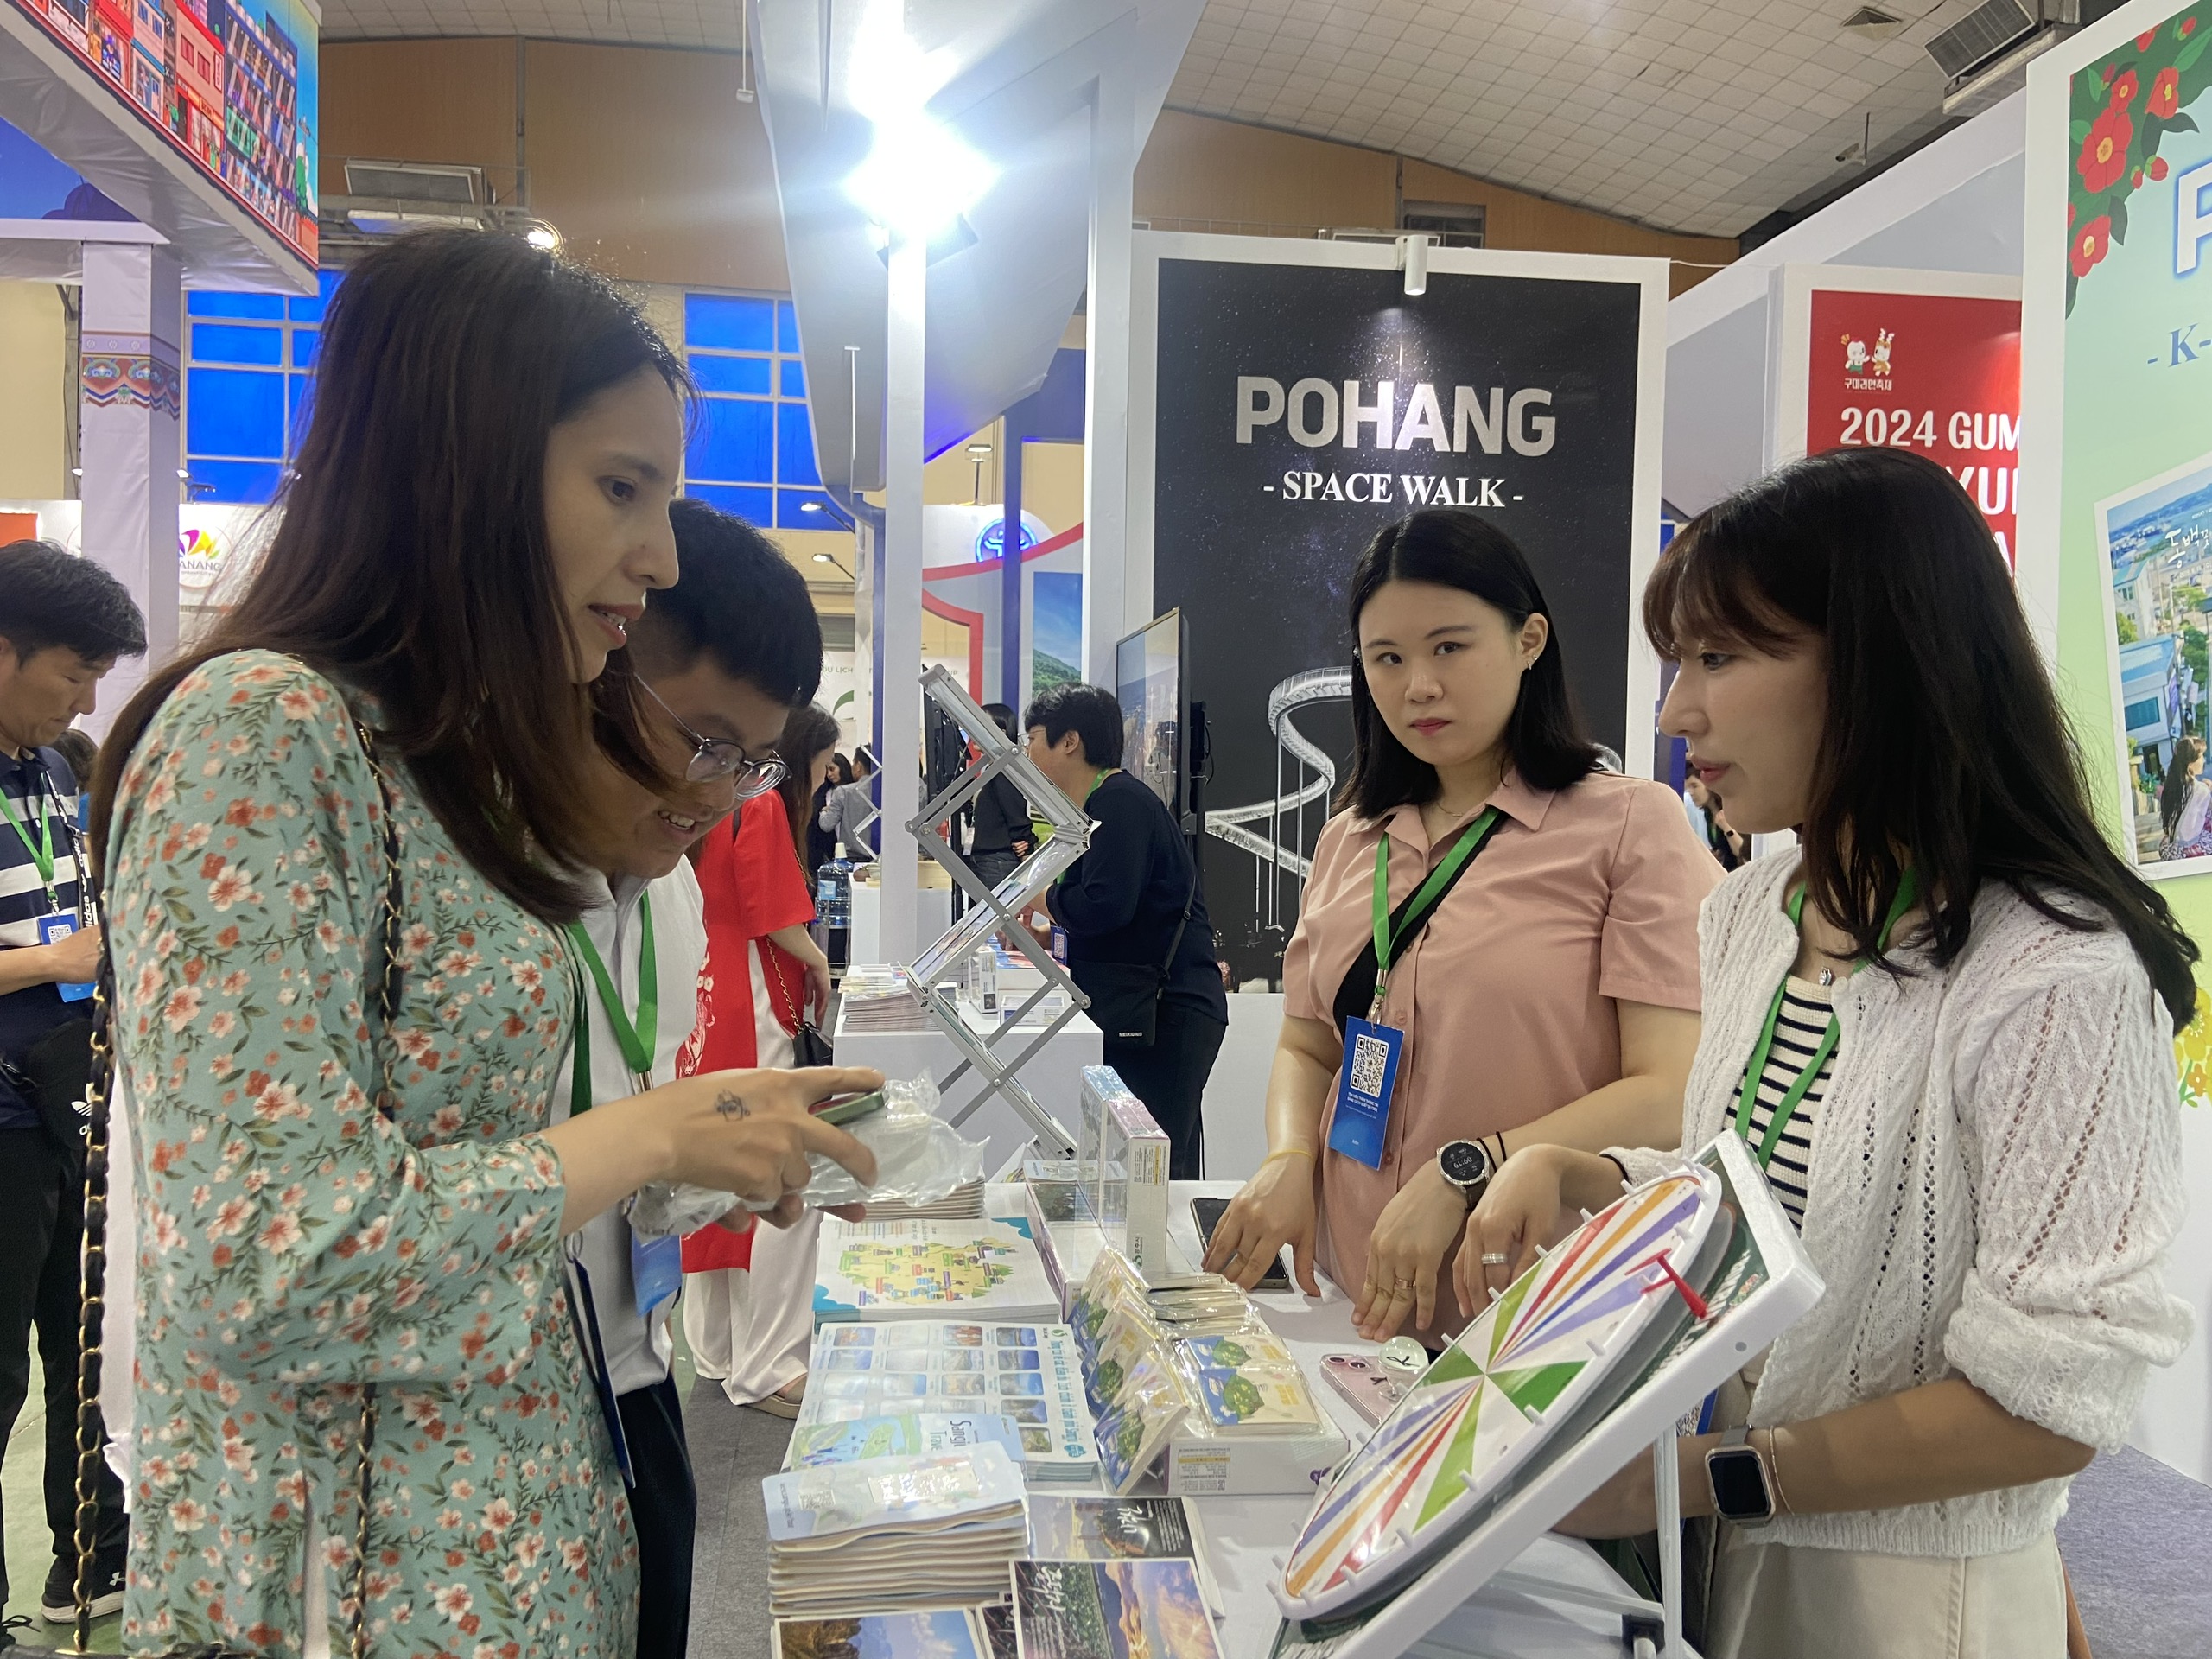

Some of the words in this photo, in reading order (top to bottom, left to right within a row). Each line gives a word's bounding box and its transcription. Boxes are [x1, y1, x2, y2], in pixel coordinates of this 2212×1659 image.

[1236, 375, 1556, 457] POHANG
[1840, 406, 1937, 448] 2024
[1282, 471, 1393, 504] SPACE
[1400, 475, 1506, 508] WALK
[180, 559, 223, 572] ANANG
